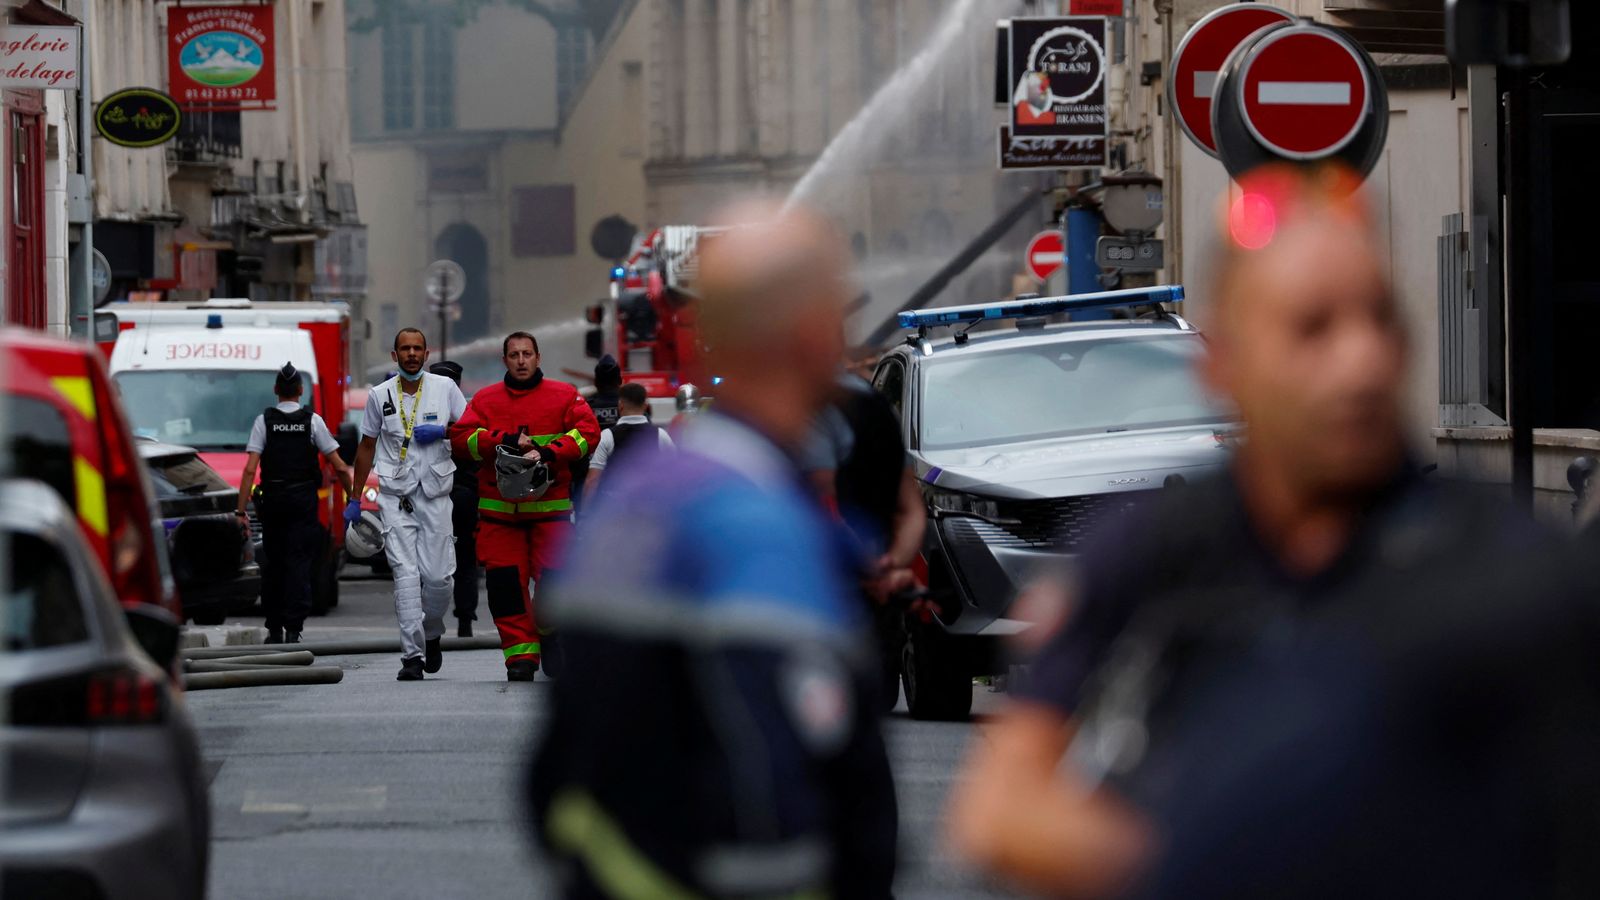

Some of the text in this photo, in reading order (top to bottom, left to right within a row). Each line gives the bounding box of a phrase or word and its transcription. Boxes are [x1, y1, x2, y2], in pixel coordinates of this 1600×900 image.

[187, 8, 254, 22] Restaurant
[1042, 62, 1091, 74] TORANJ
[1056, 114, 1106, 124] IRANIEN
[594, 407, 618, 417] POLI
[273, 424, 305, 432] POLICE
